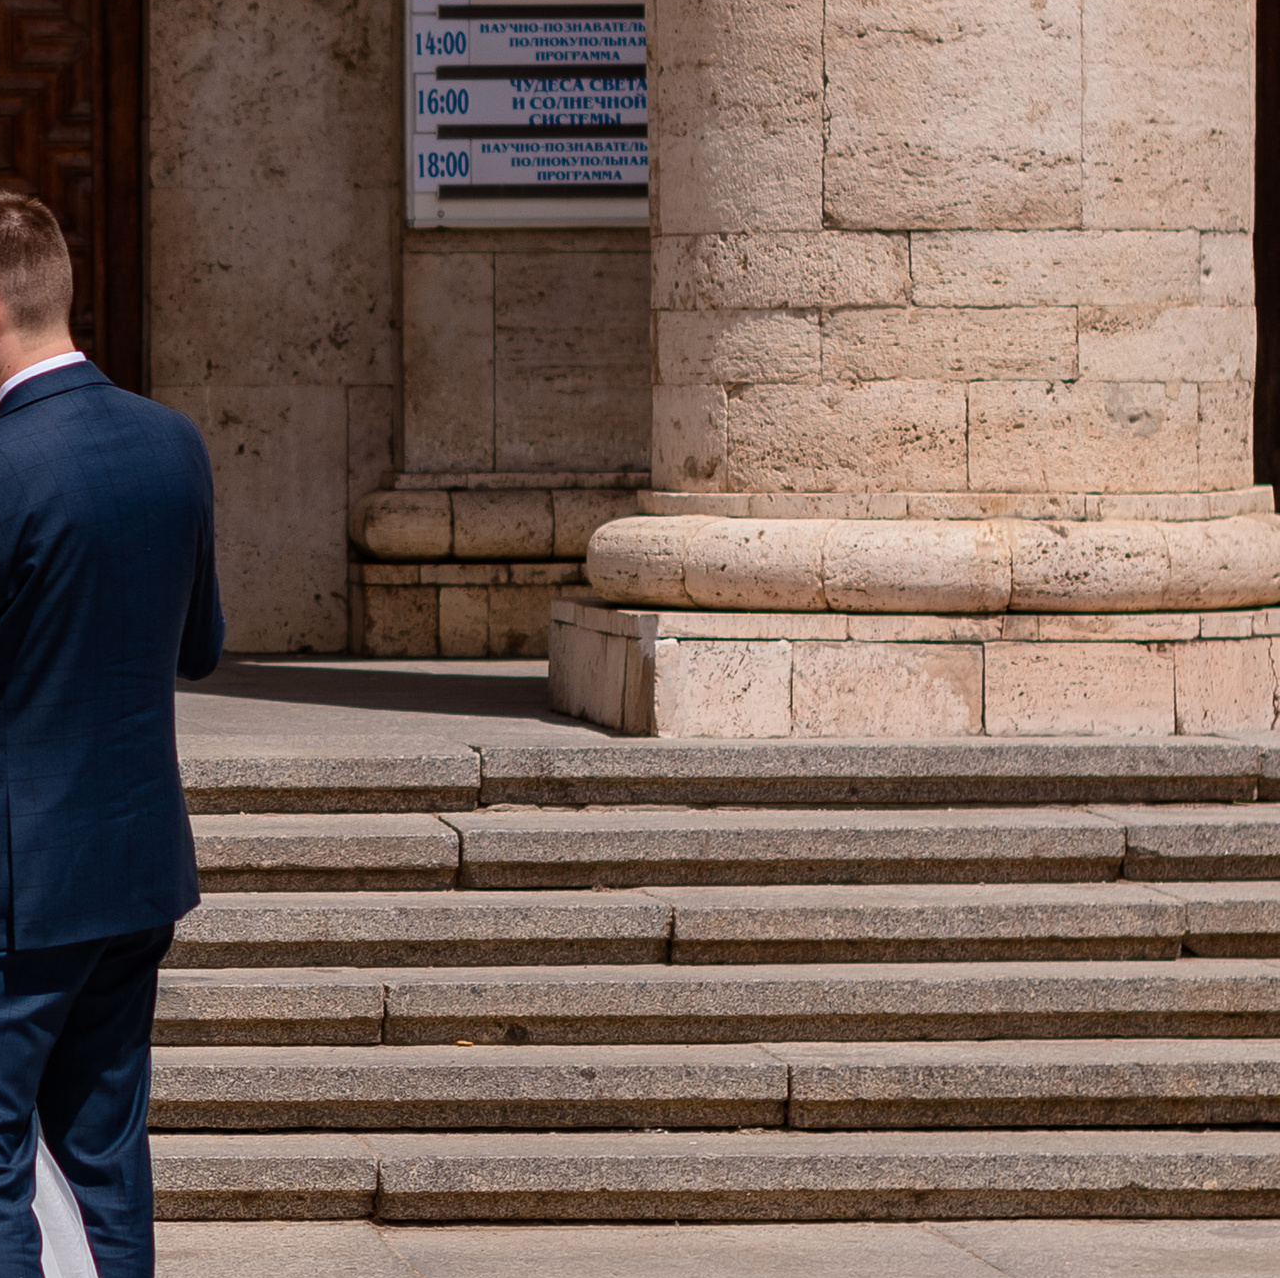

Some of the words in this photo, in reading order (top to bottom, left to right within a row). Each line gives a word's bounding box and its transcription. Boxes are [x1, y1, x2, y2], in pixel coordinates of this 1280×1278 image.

[416, 31, 467, 56] 14:00
[509, 37, 646, 48] ПОЛНОКУПОЛЬНАЯ
[535, 50, 620, 62] ПРОГРАММА
[510, 78, 585, 94] ЧУДЕСА
[589, 77, 647, 91] СВЕТА
[417, 88, 469, 115] 16:00
[512, 98, 525, 110] И
[530, 95, 646, 110] СОЛНЕЧНОЙ
[529, 113, 622, 126] СИСТЕМЫ
[418, 151, 469, 178] 18:00
[511, 156, 648, 167] ПОЛНОКУПОЛЬНАЯ
[537, 170, 622, 181] ПРОГРАММА
